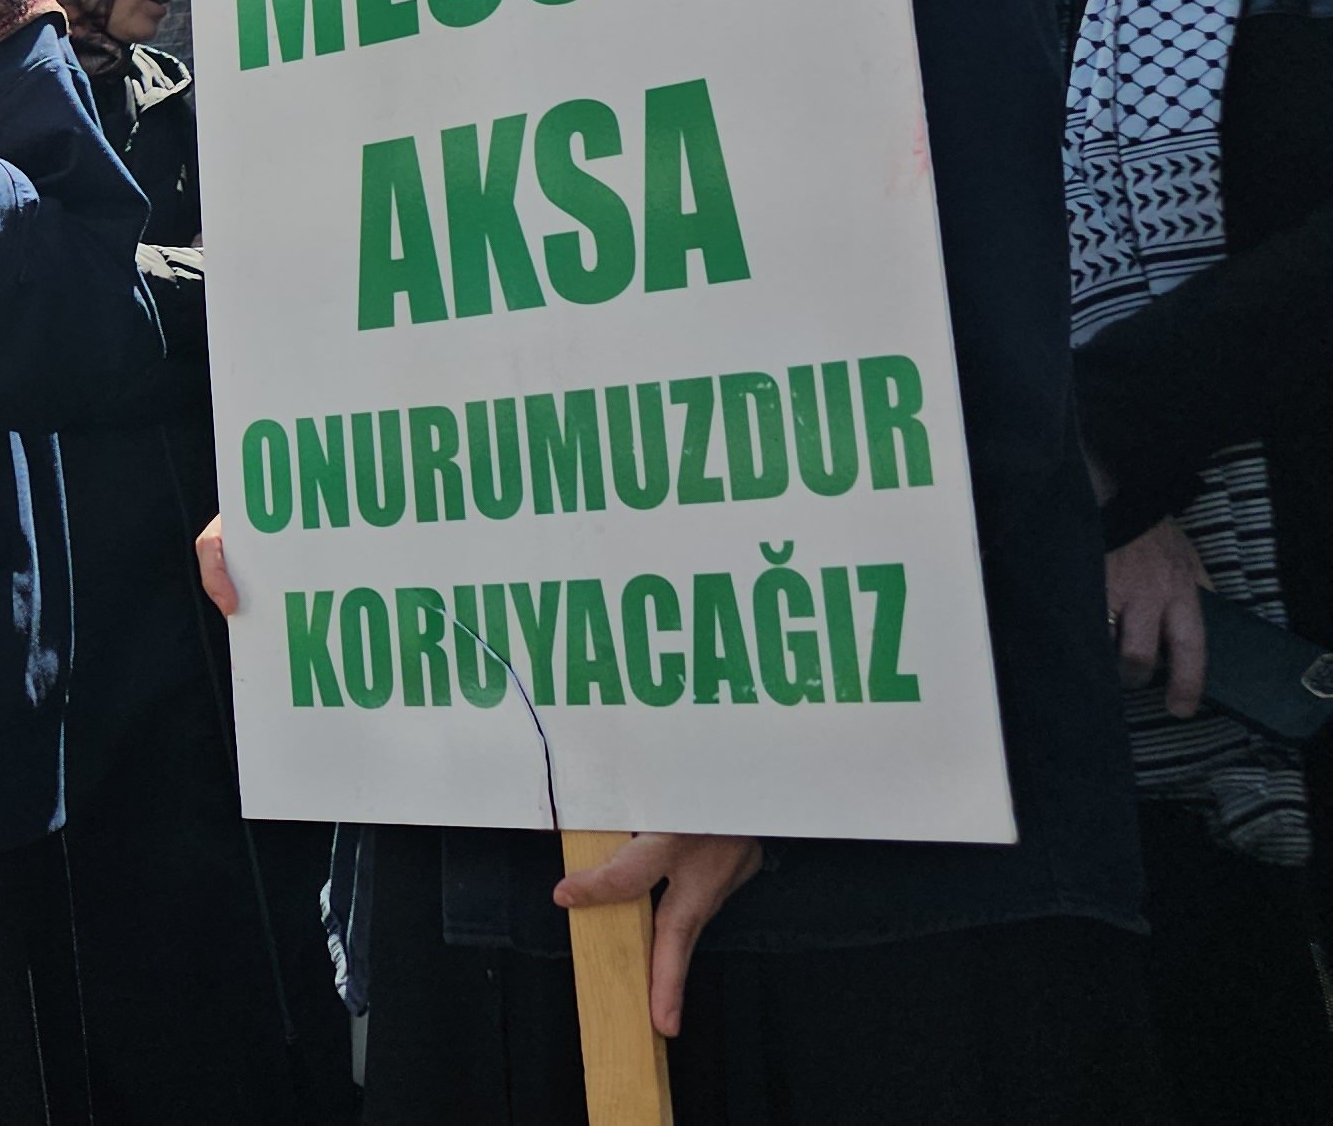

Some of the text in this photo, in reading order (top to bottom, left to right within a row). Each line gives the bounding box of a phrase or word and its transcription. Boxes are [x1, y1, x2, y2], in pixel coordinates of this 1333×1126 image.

[357, 78, 752, 331] AKSA
[242, 355, 933, 533] ONURUMUZDUR
[284, 540, 921, 709] KORUYACAĞIZ
